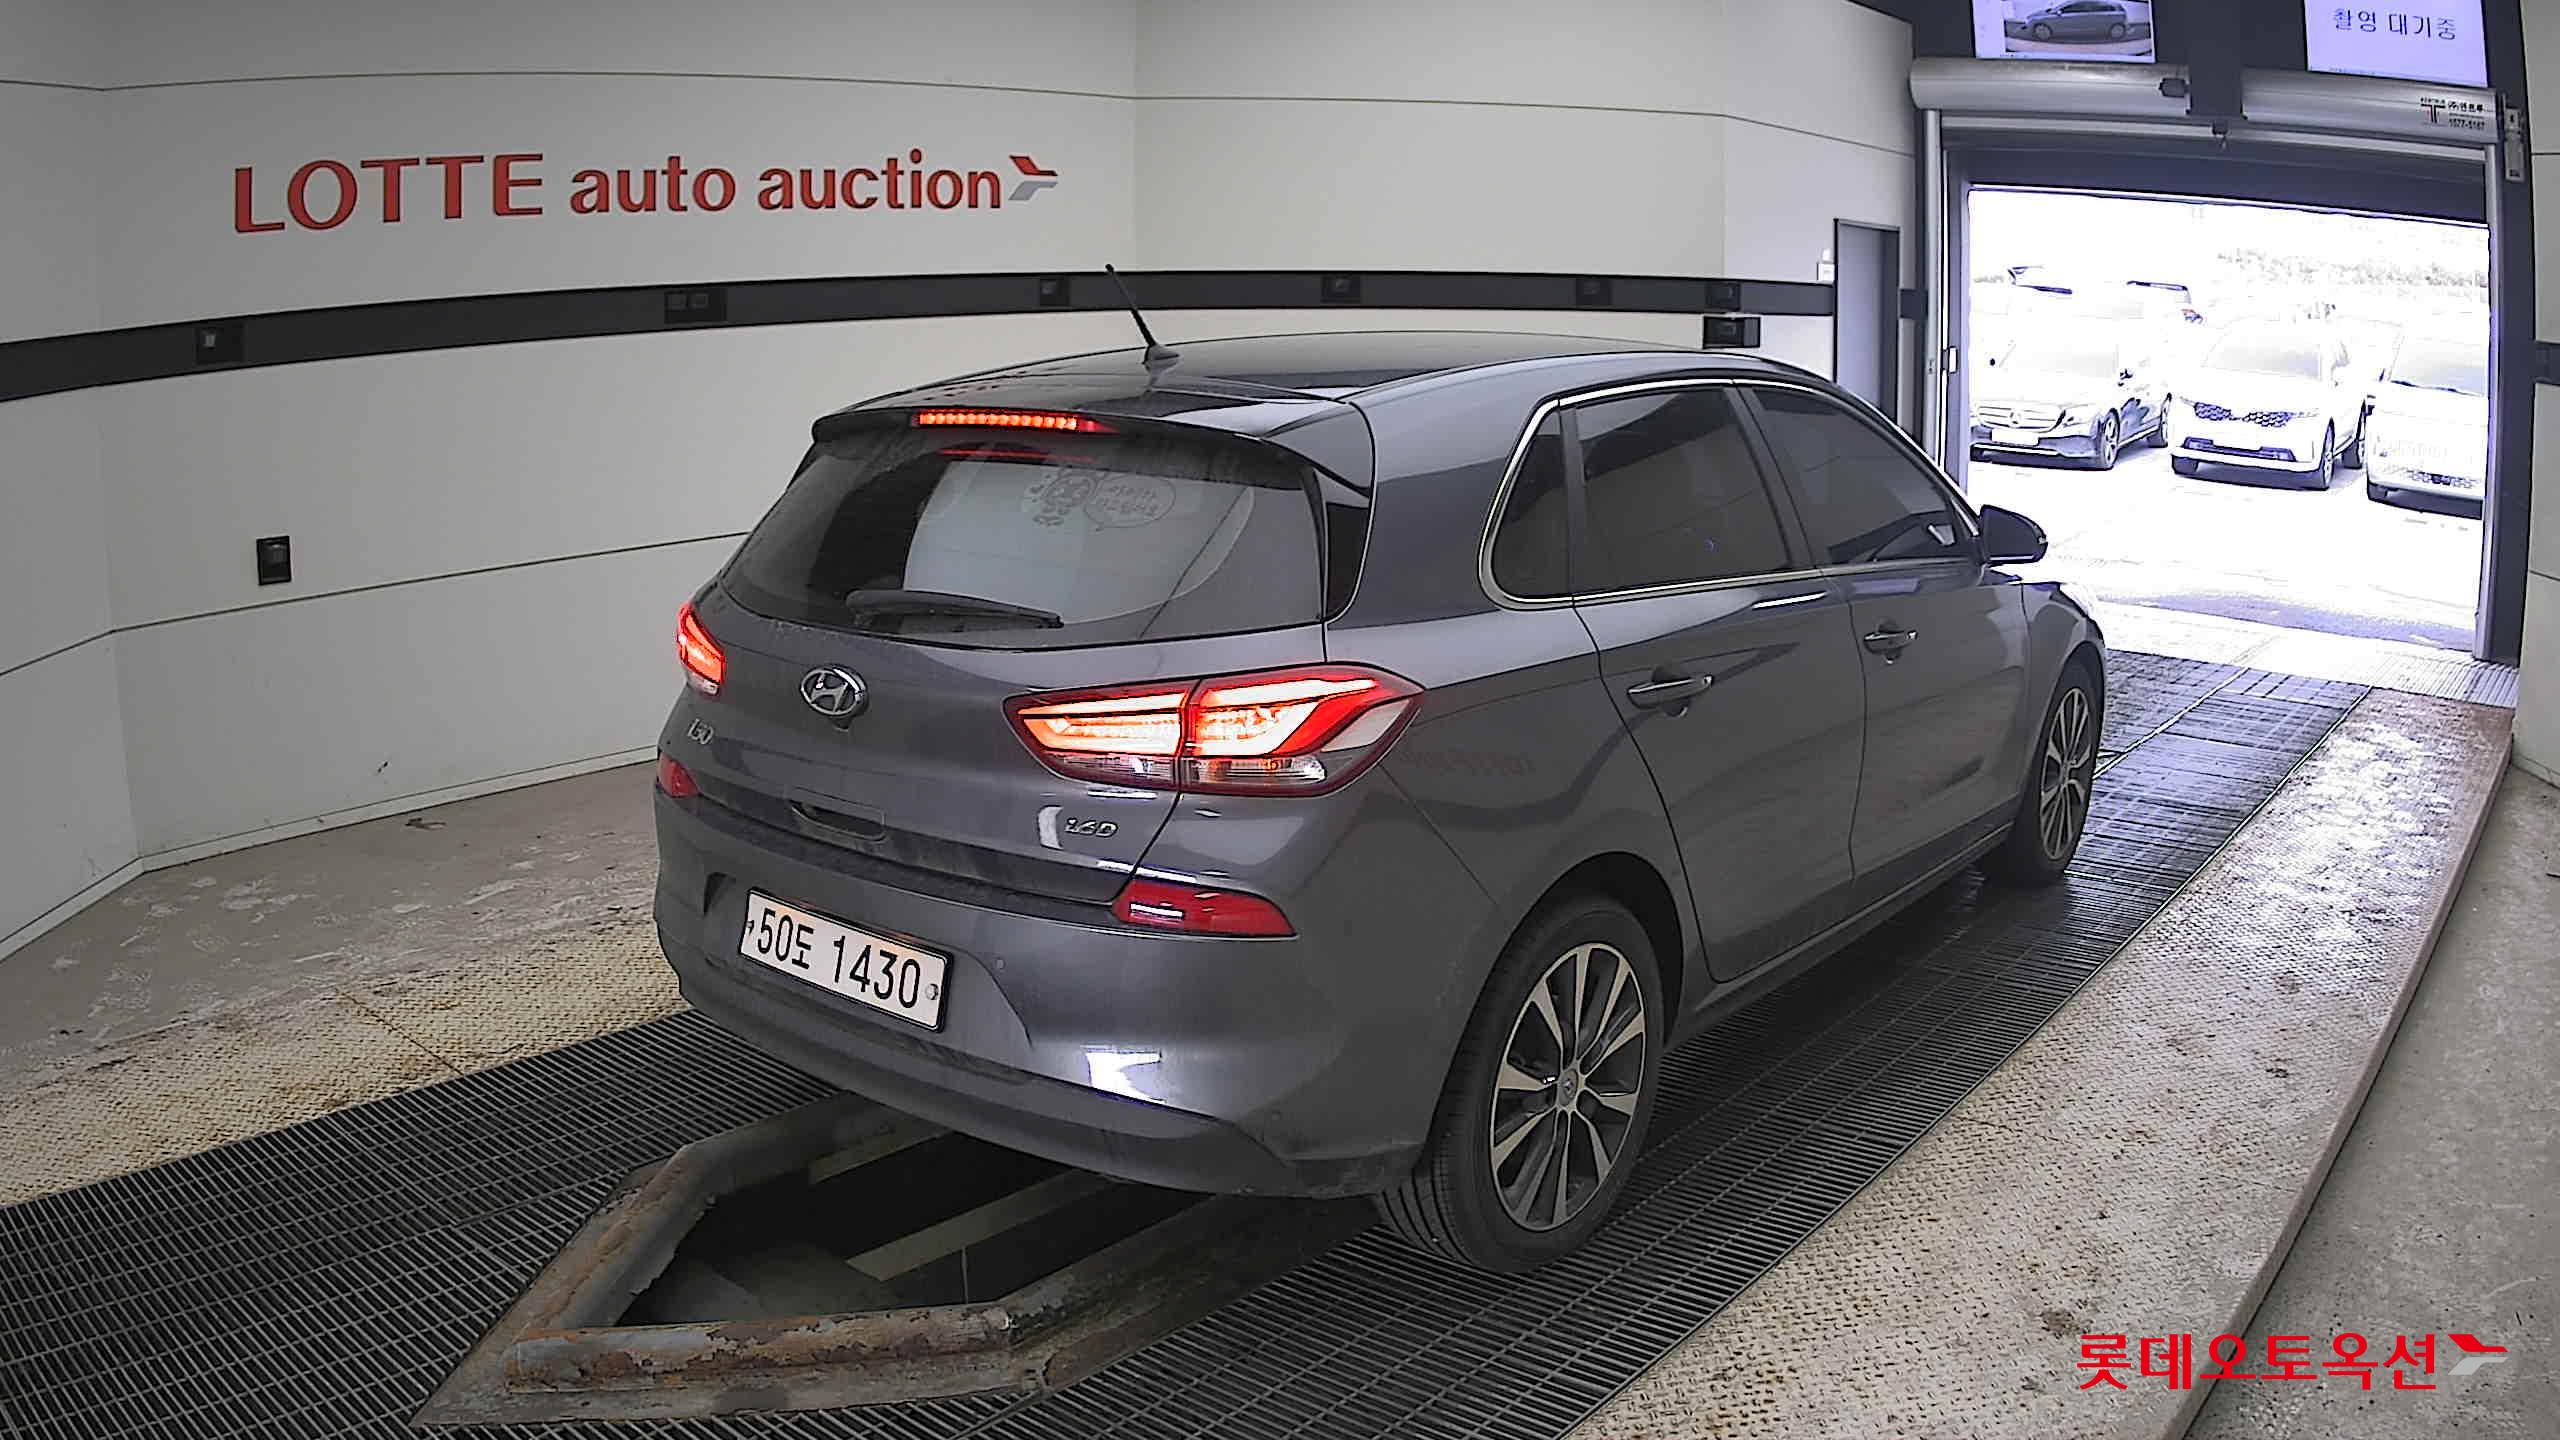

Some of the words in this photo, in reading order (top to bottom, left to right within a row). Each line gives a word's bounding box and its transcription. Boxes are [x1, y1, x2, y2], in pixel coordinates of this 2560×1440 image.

[2333, 8, 2377, 33] 촬영
[2388, 12, 2456, 40] 대기중
[234, 153, 544, 233] LOTTE
[569, 155, 737, 214] auto
[757, 148, 1001, 210] auction
[757, 907, 815, 970] 50도
[833, 935, 921, 1009] 1430
